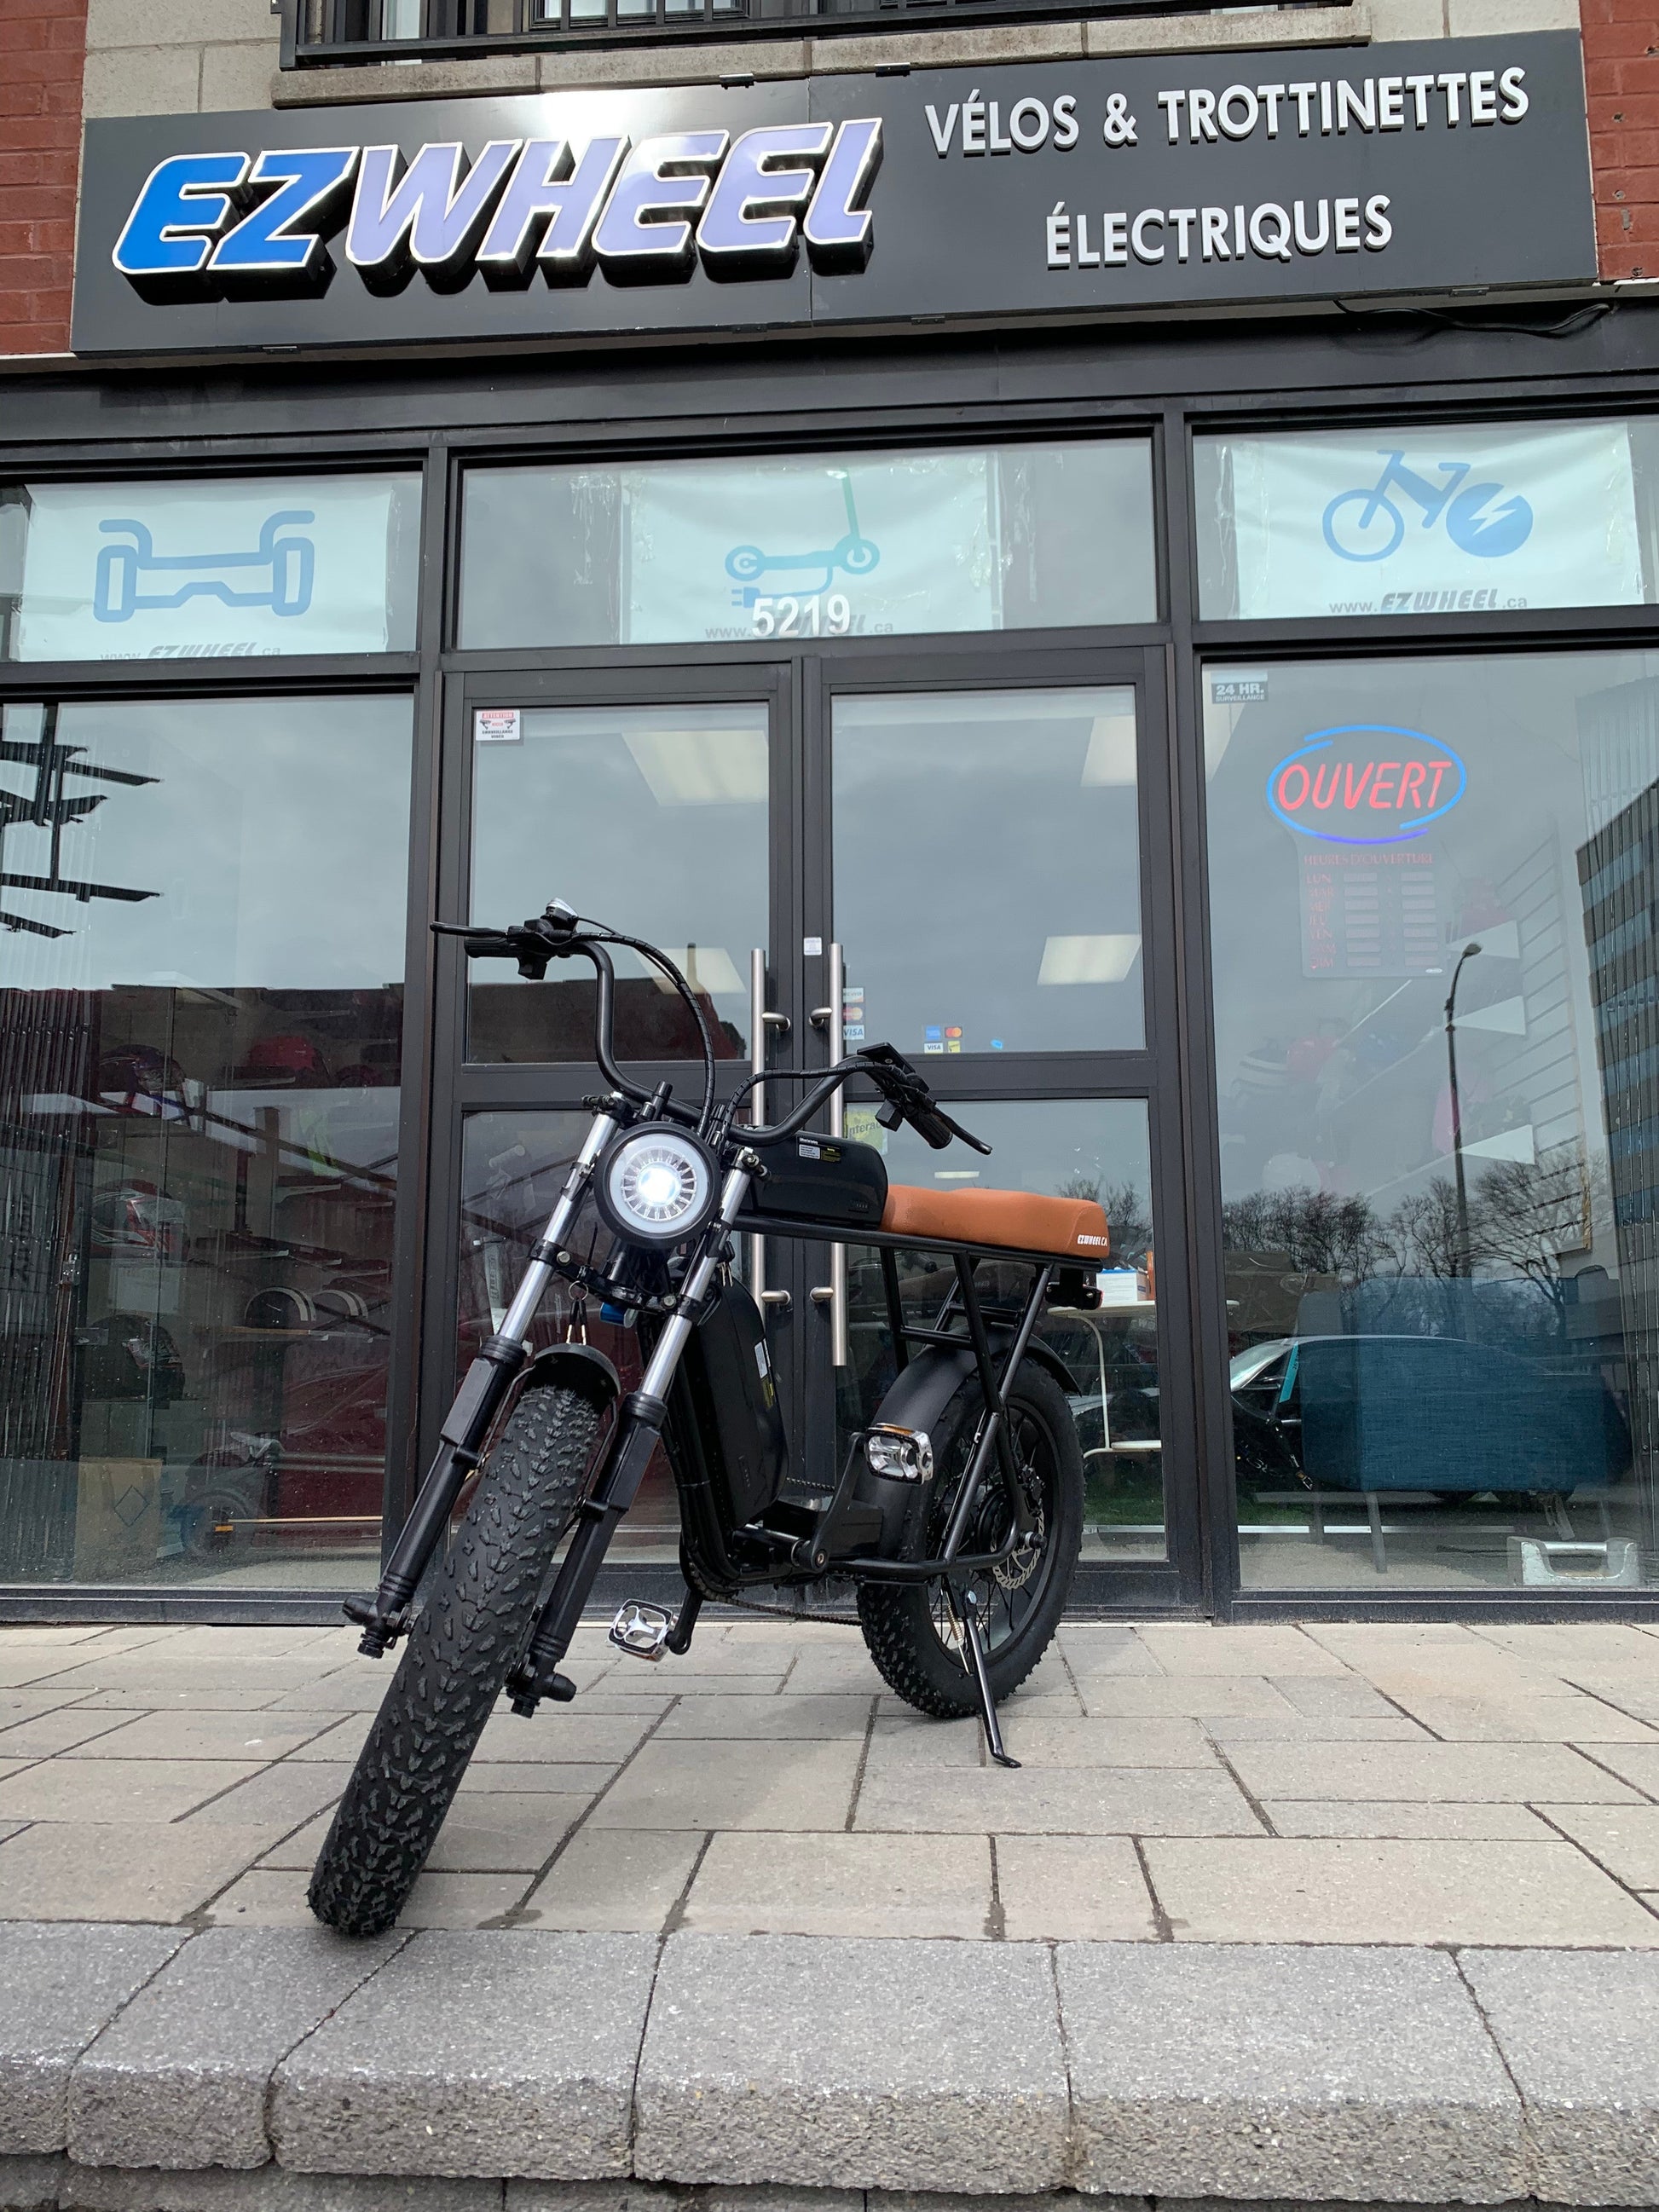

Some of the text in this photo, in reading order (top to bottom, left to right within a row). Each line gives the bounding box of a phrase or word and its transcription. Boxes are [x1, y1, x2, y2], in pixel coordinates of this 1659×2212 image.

[924, 66, 1530, 159] VÉLOS & TROTTINETTES
[112, 117, 884, 275] EZWHEEL
[1046, 194, 1394, 269] ÉLECTRIQUES
[752, 594, 851, 638] 5219
[1216, 683, 1264, 696] 24 HR.
[1278, 761, 1452, 810] OUVERT
[844, 1028, 864, 1037] VISA
